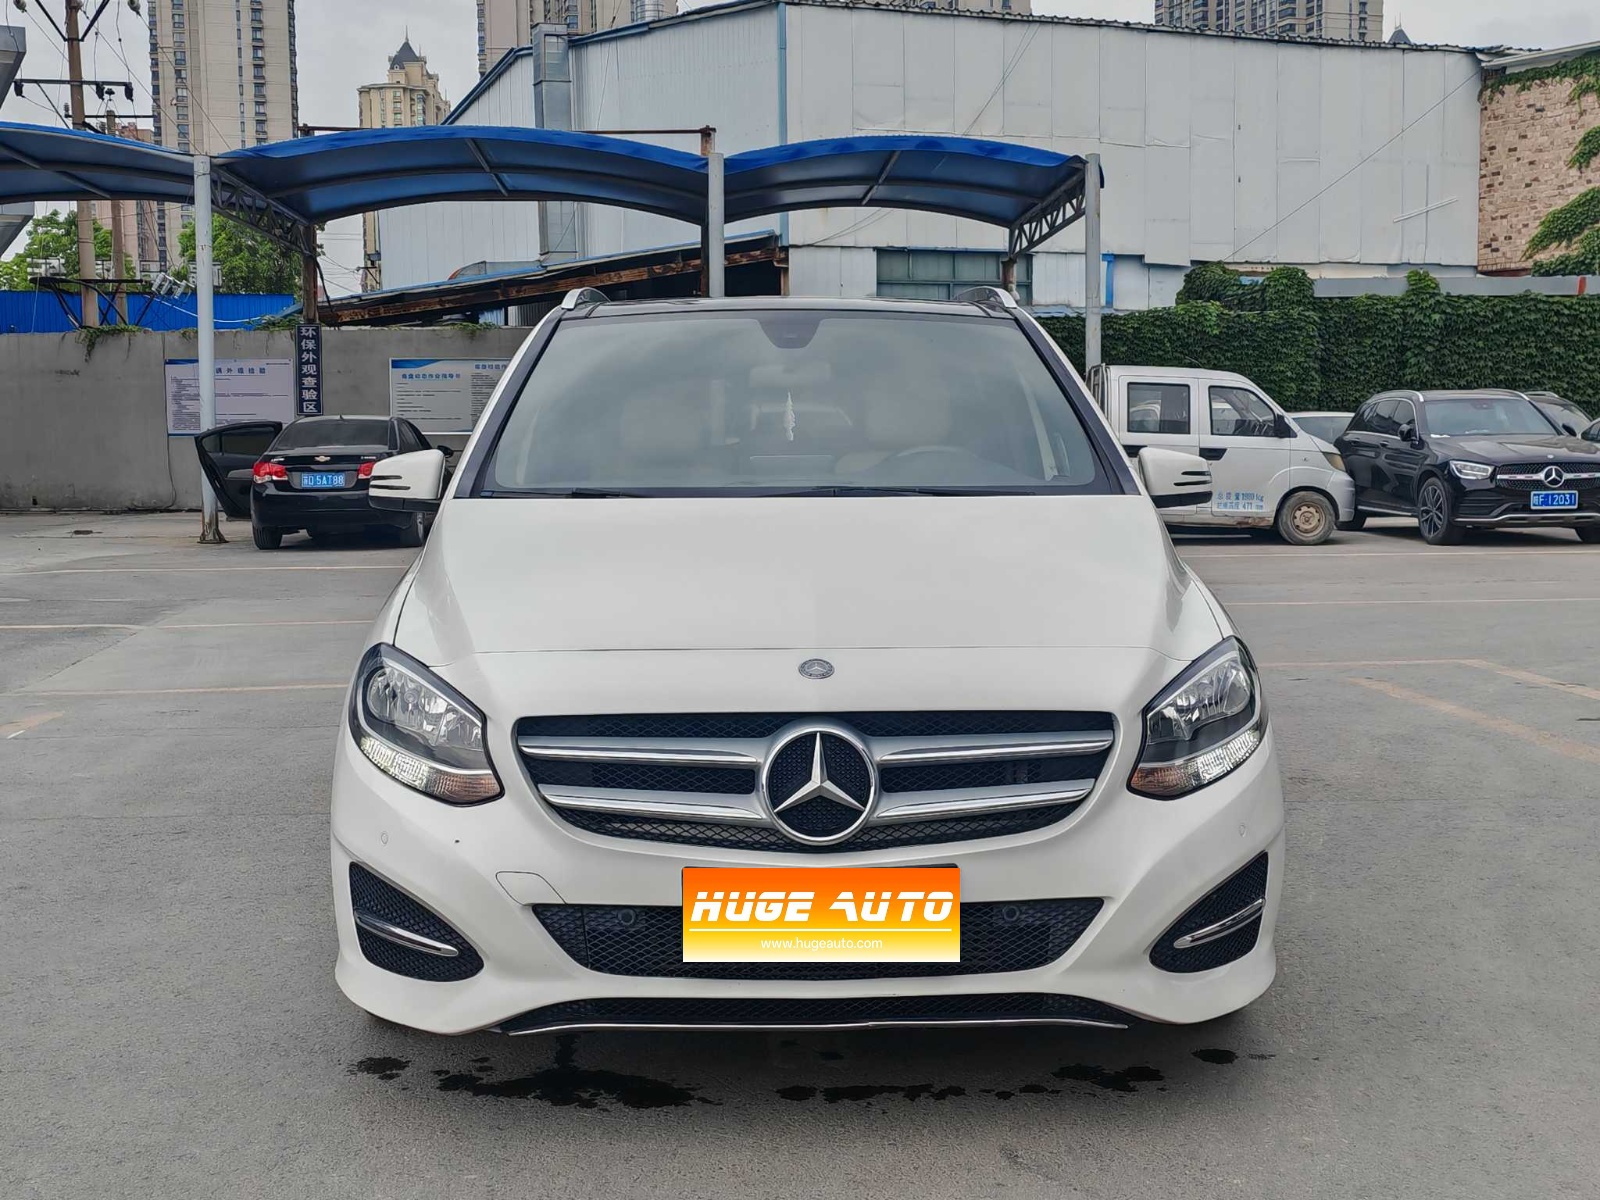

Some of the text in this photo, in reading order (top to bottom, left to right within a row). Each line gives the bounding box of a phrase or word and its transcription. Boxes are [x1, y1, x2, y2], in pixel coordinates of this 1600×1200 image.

[300, 326, 318, 413] 环保外观查验区
